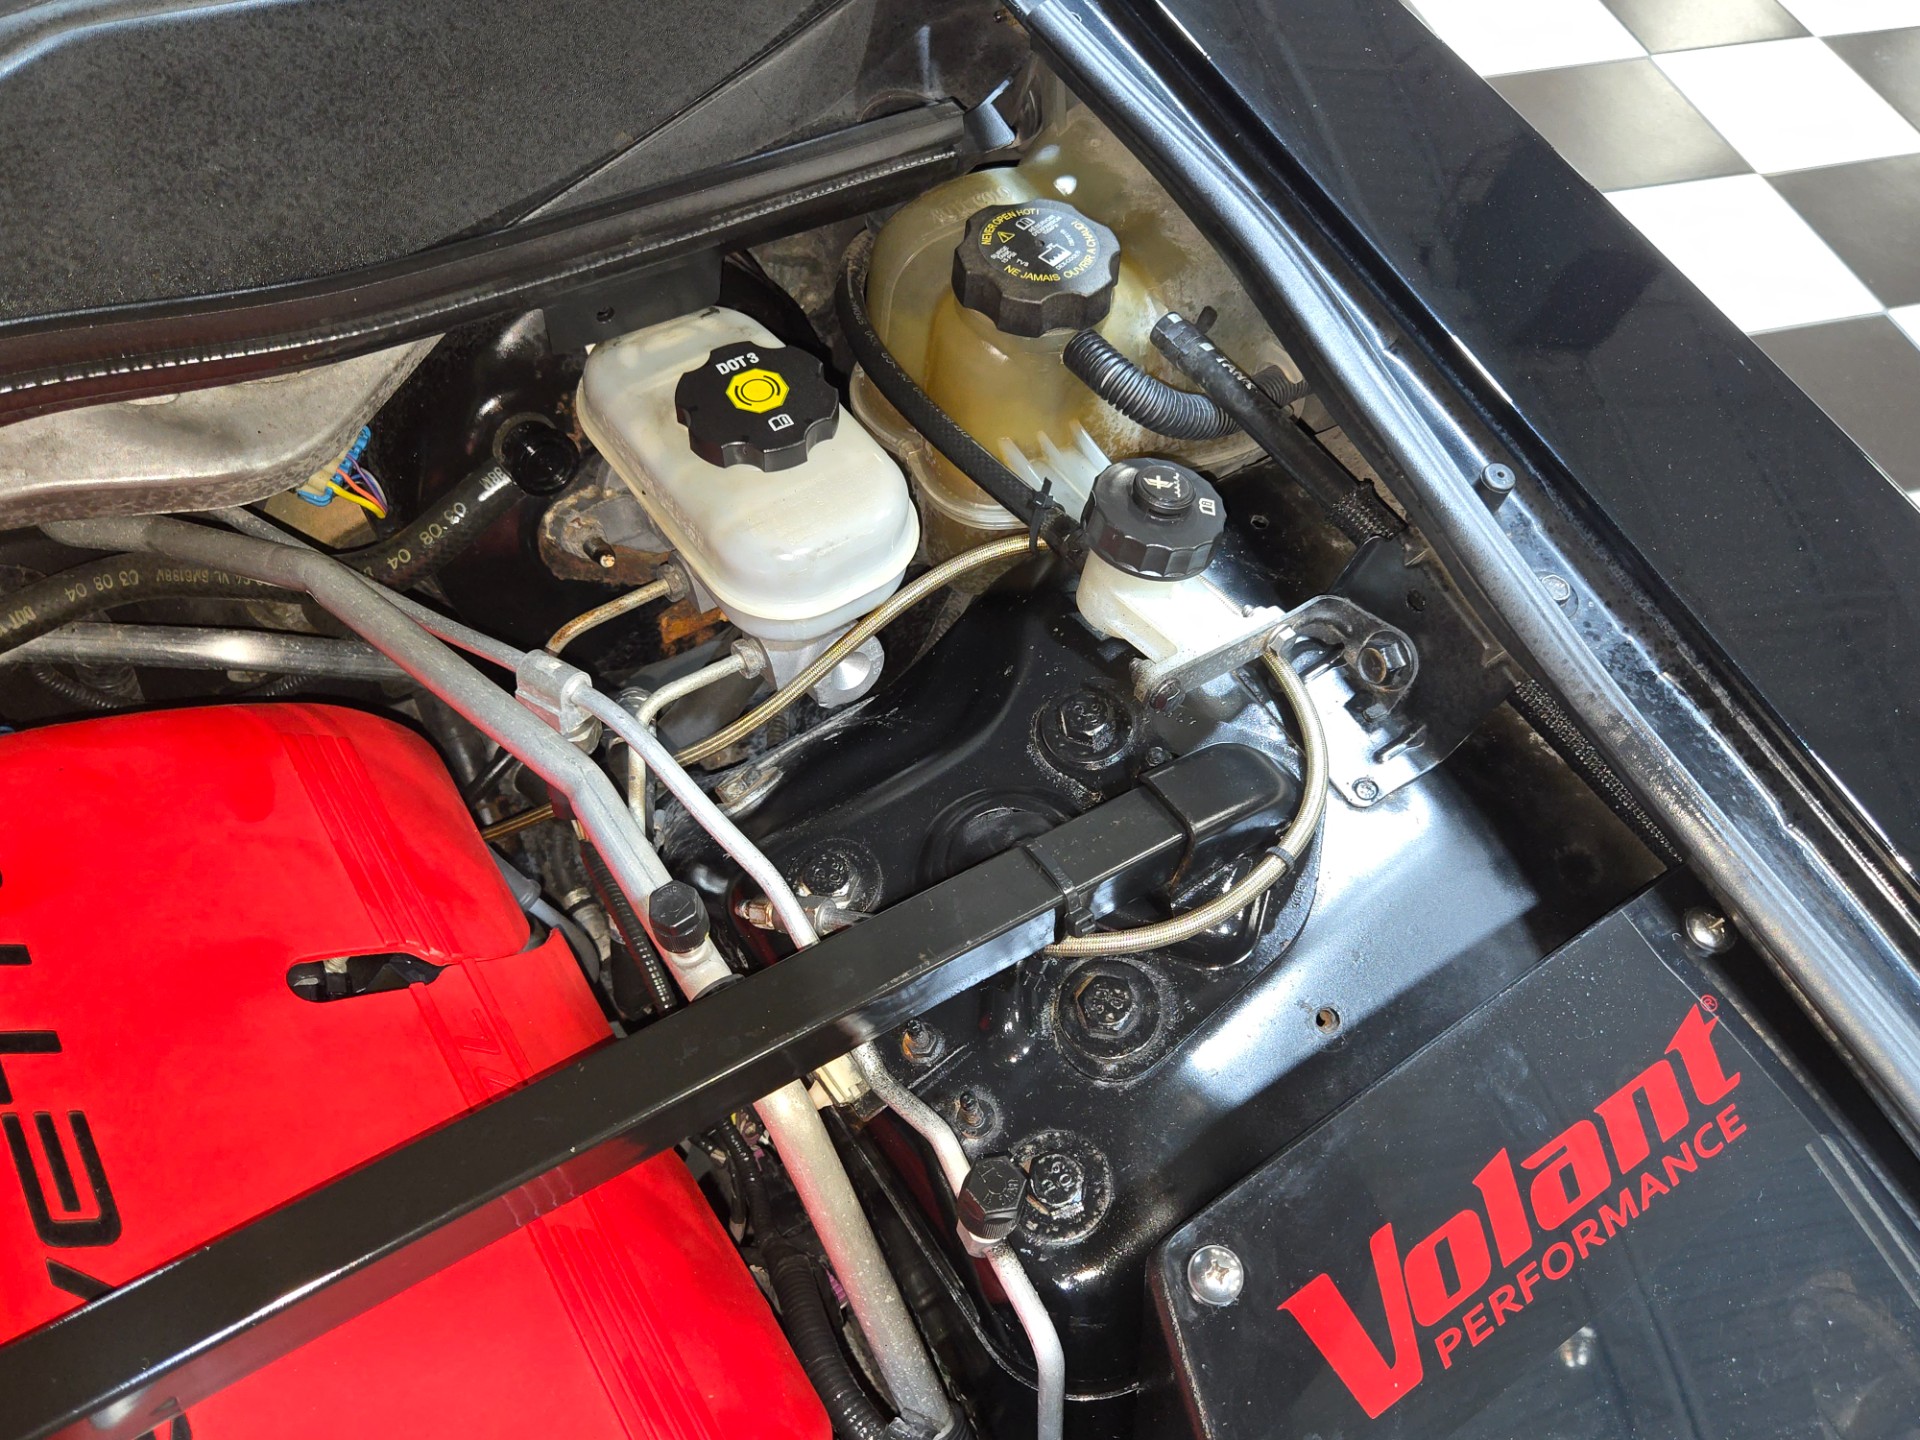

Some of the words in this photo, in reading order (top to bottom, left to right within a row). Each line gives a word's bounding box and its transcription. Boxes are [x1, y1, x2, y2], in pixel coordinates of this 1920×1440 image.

[981, 223, 996, 245] NEVER
[992, 210, 1017, 225] OPEN
[1004, 264, 1021, 276] NE
[1020, 271, 1061, 281] JAMAIS
[1063, 254, 1095, 279] OUVRIR
[715, 355, 747, 375] DOT
[746, 352, 760, 364] 3
[419, 523, 443, 545] 08
[387, 549, 411, 570] 04
[93, 574, 114, 591] 08
[118, 569, 139, 587] 03
[65, 583, 87, 602] 04
[1276, 1003, 1742, 1419] Volant
[1434, 1103, 1748, 1370] PERFORMANCE
